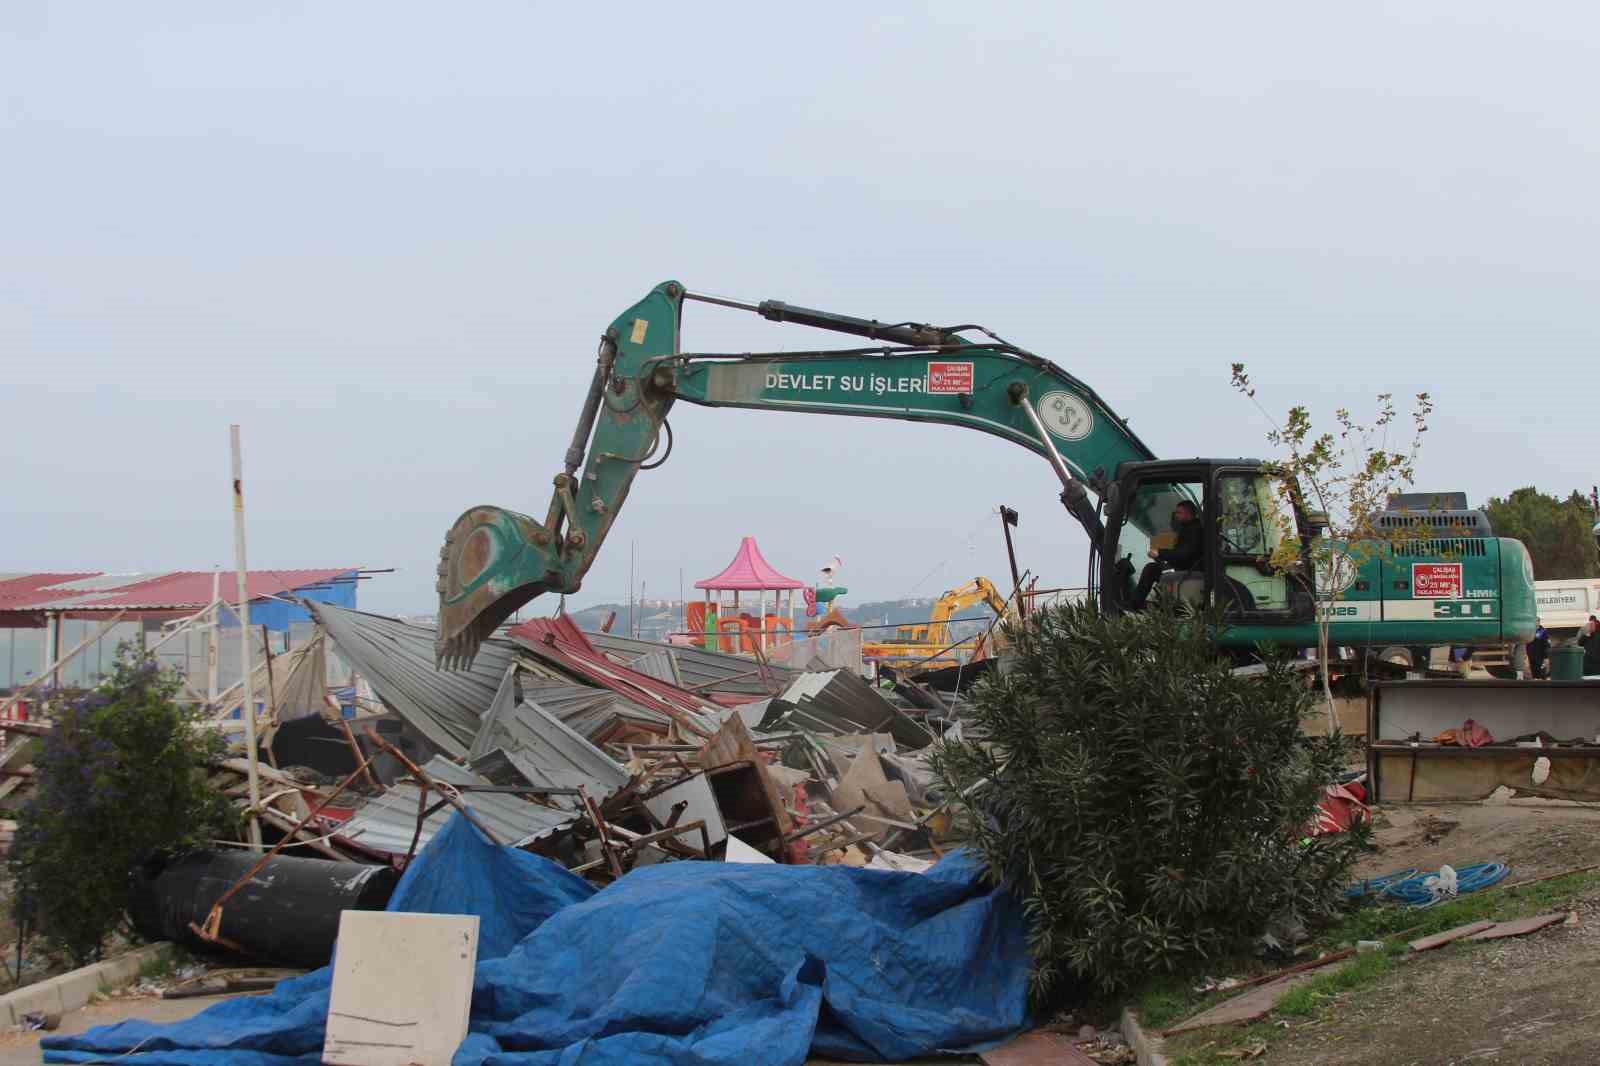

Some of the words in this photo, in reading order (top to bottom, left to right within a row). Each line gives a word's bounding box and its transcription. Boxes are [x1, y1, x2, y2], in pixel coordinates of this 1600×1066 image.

[766, 373, 835, 390] DEVLET
[840, 375, 864, 391] SU
[870, 373, 928, 396] İŞLERİ
